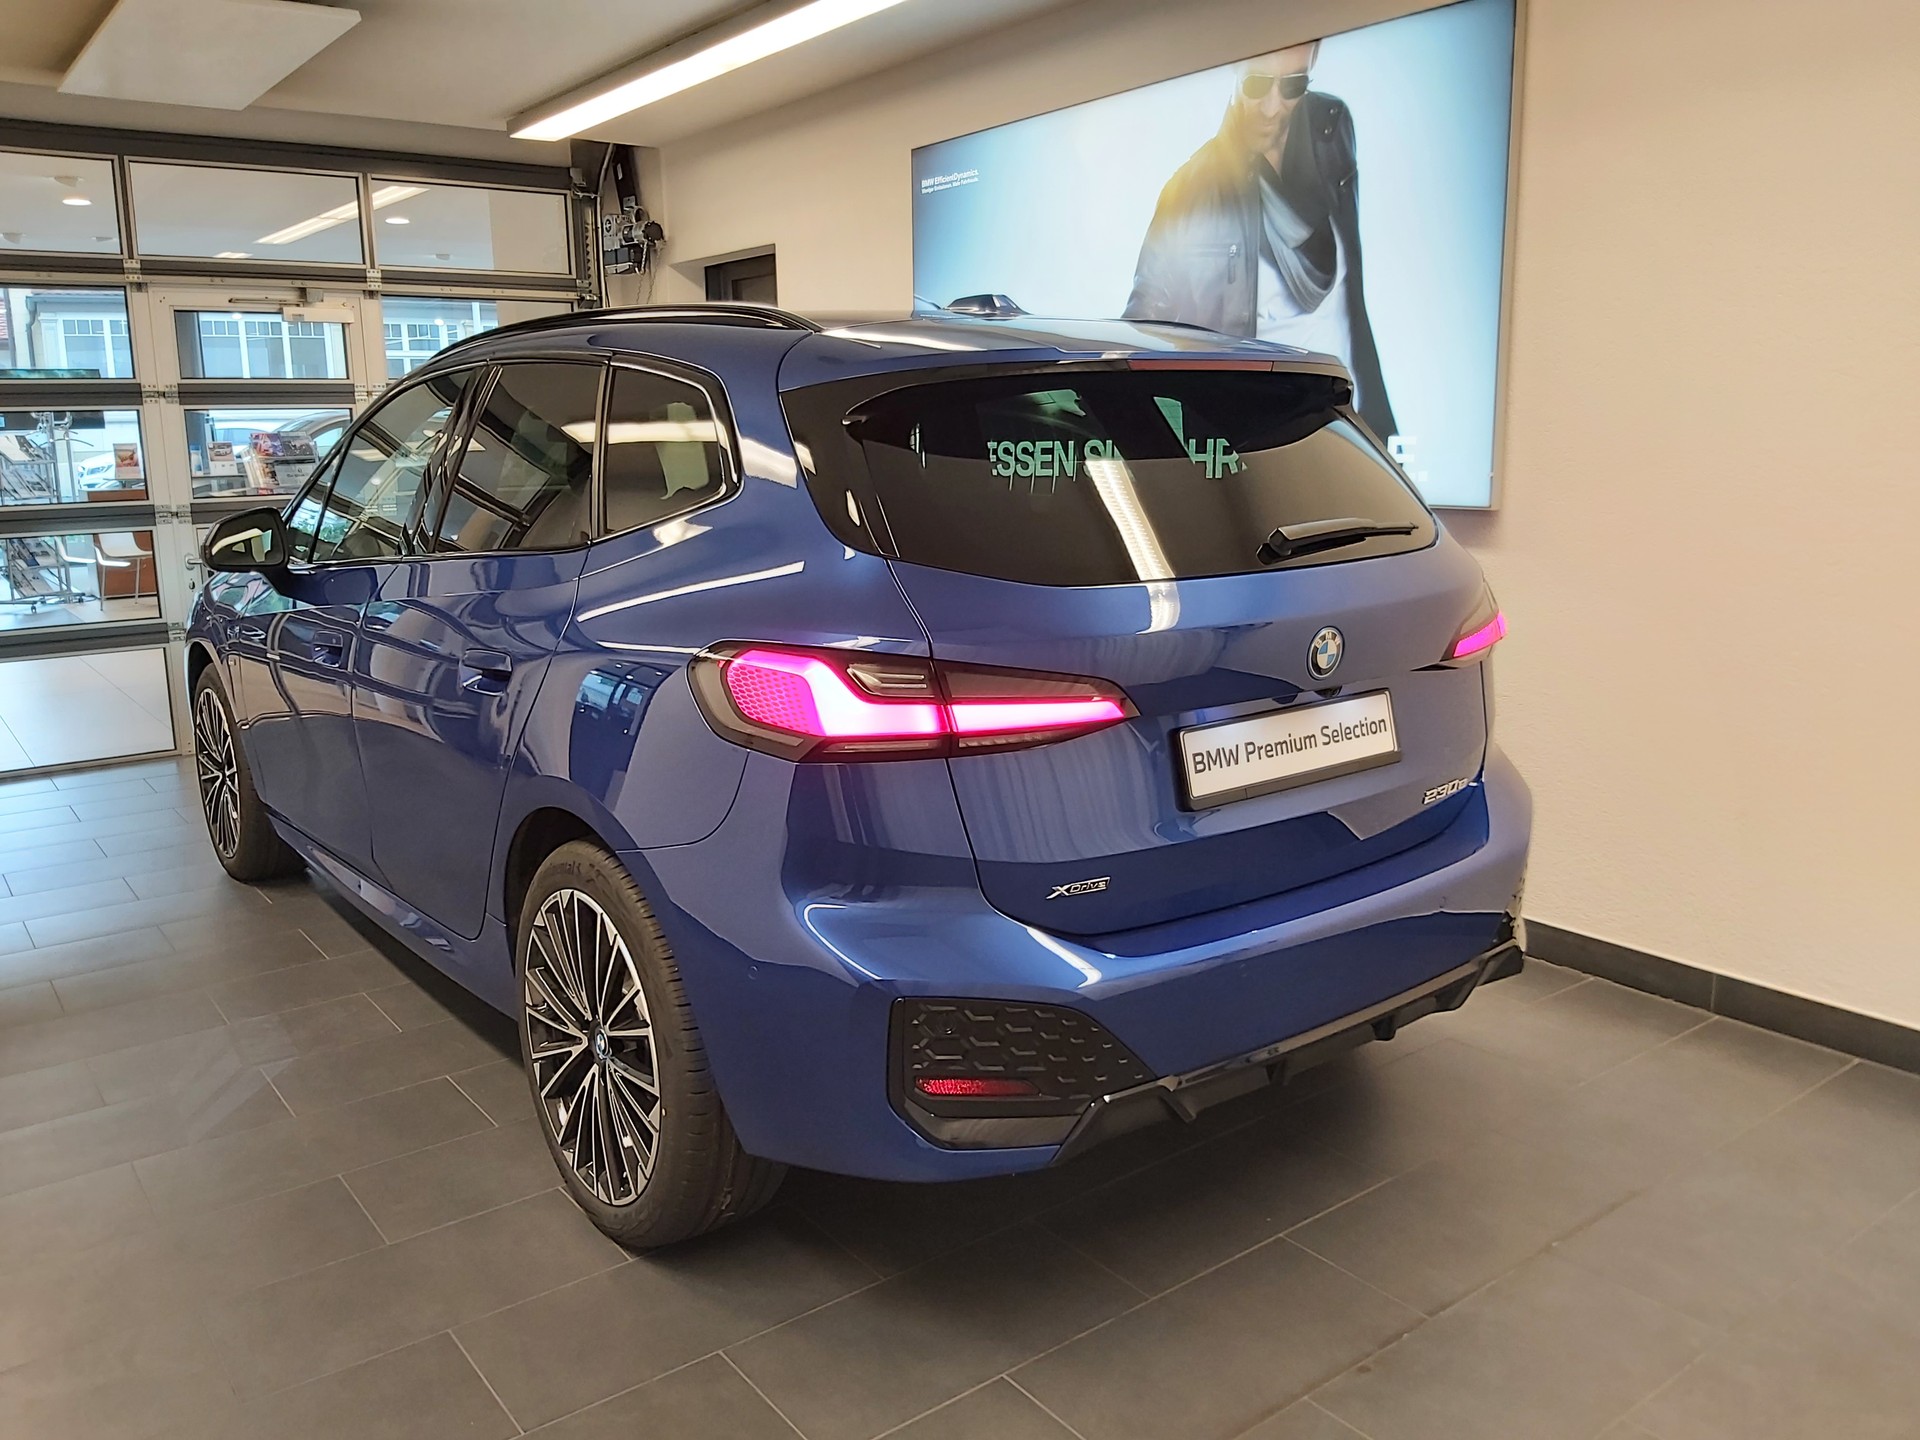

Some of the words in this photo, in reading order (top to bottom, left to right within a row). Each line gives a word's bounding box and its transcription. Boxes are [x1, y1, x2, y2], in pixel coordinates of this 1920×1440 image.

[921, 178, 935, 188] BMW
[1191, 744, 1240, 775] BMW
[1244, 733, 1318, 763] Premium
[1320, 717, 1388, 746] Selection
